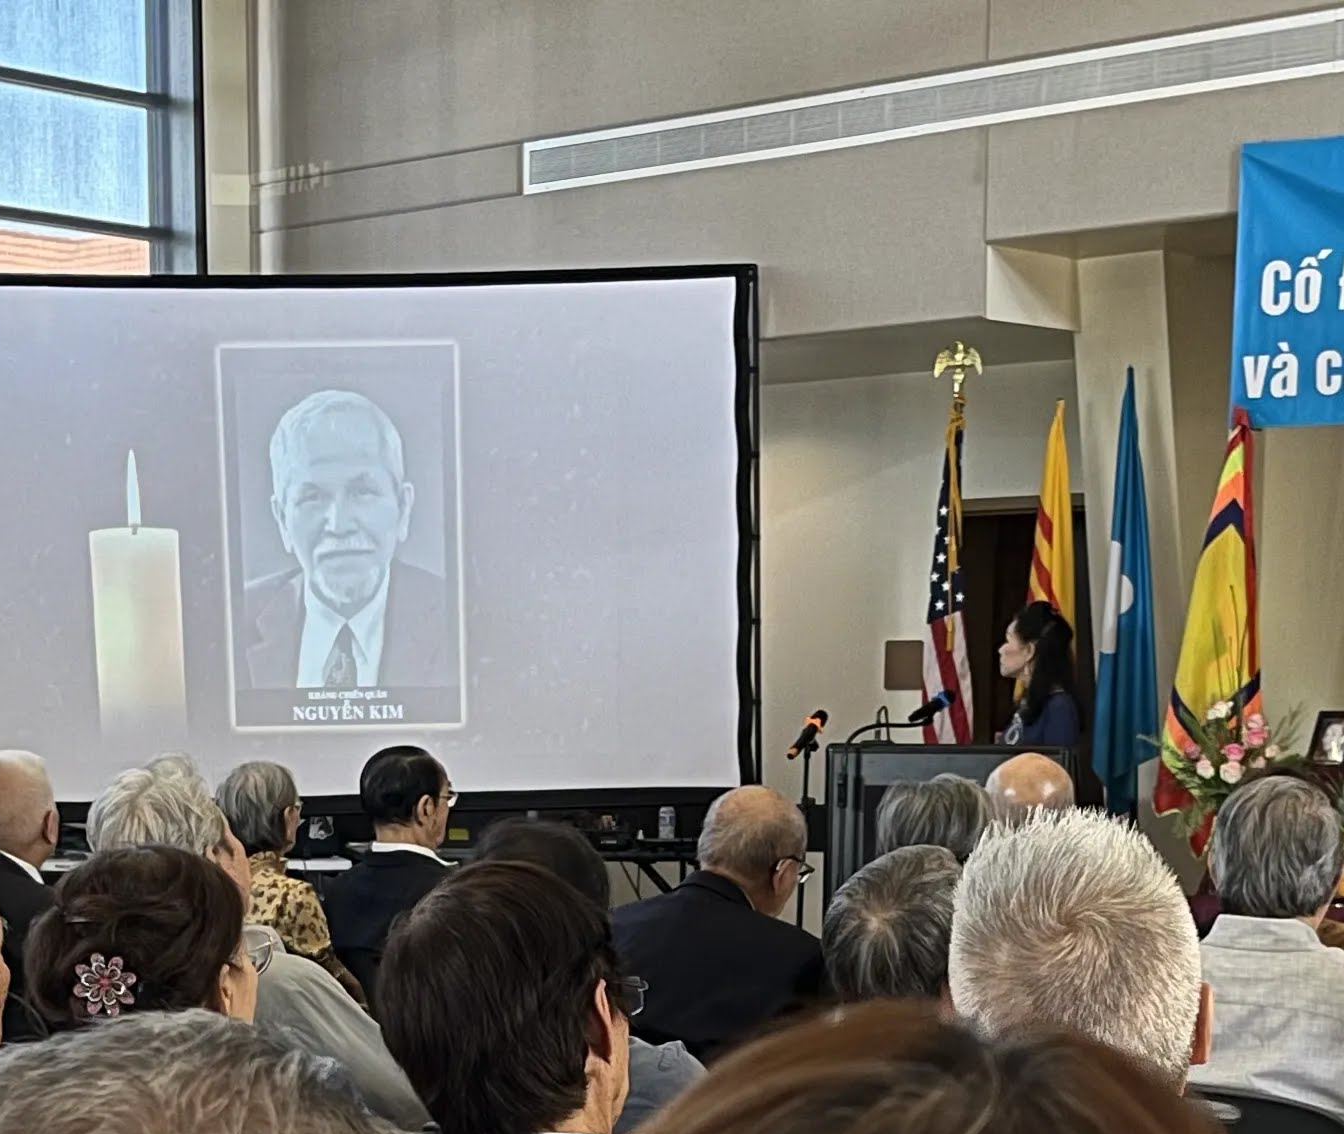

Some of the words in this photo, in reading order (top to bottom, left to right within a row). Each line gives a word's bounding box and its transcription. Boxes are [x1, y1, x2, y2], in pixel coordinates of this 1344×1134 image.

[1260, 248, 1334, 316] Cố
[1243, 341, 1299, 399] và
[368, 703, 404, 720] KIM
